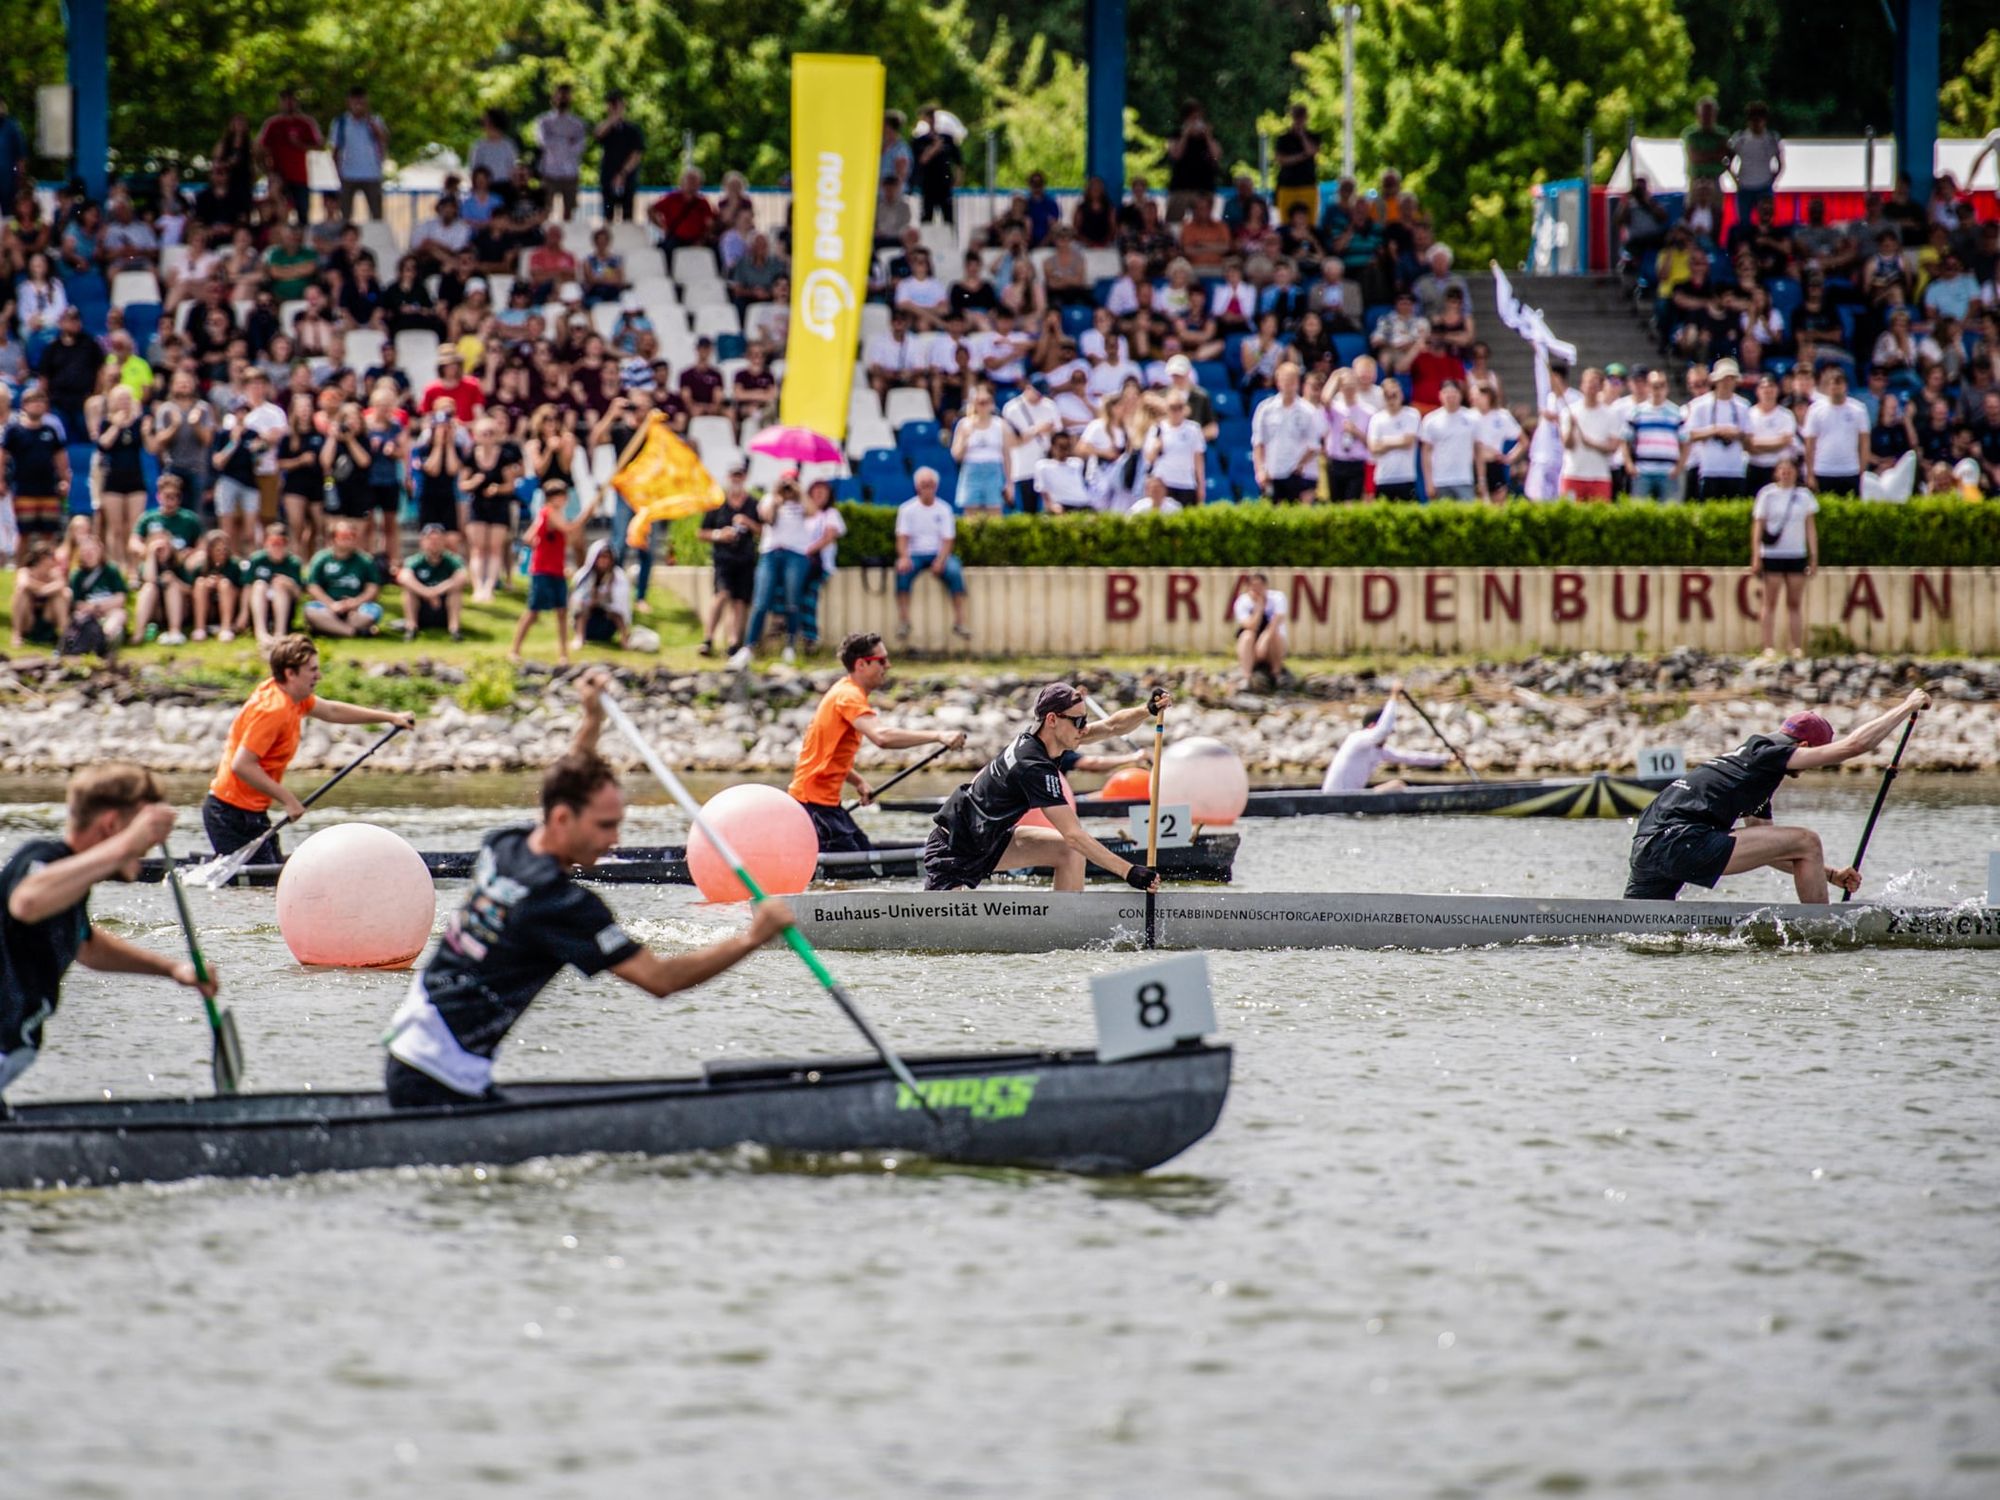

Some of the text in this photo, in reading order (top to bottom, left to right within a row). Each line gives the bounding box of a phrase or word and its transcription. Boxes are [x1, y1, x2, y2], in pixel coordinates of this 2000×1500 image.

[1842, 572, 1953, 622] AN
[1650, 752, 1675, 773] 10
[814, 901, 1050, 922] Bauhaus-Universität Weimar
[1137, 981, 1170, 1029] 8
